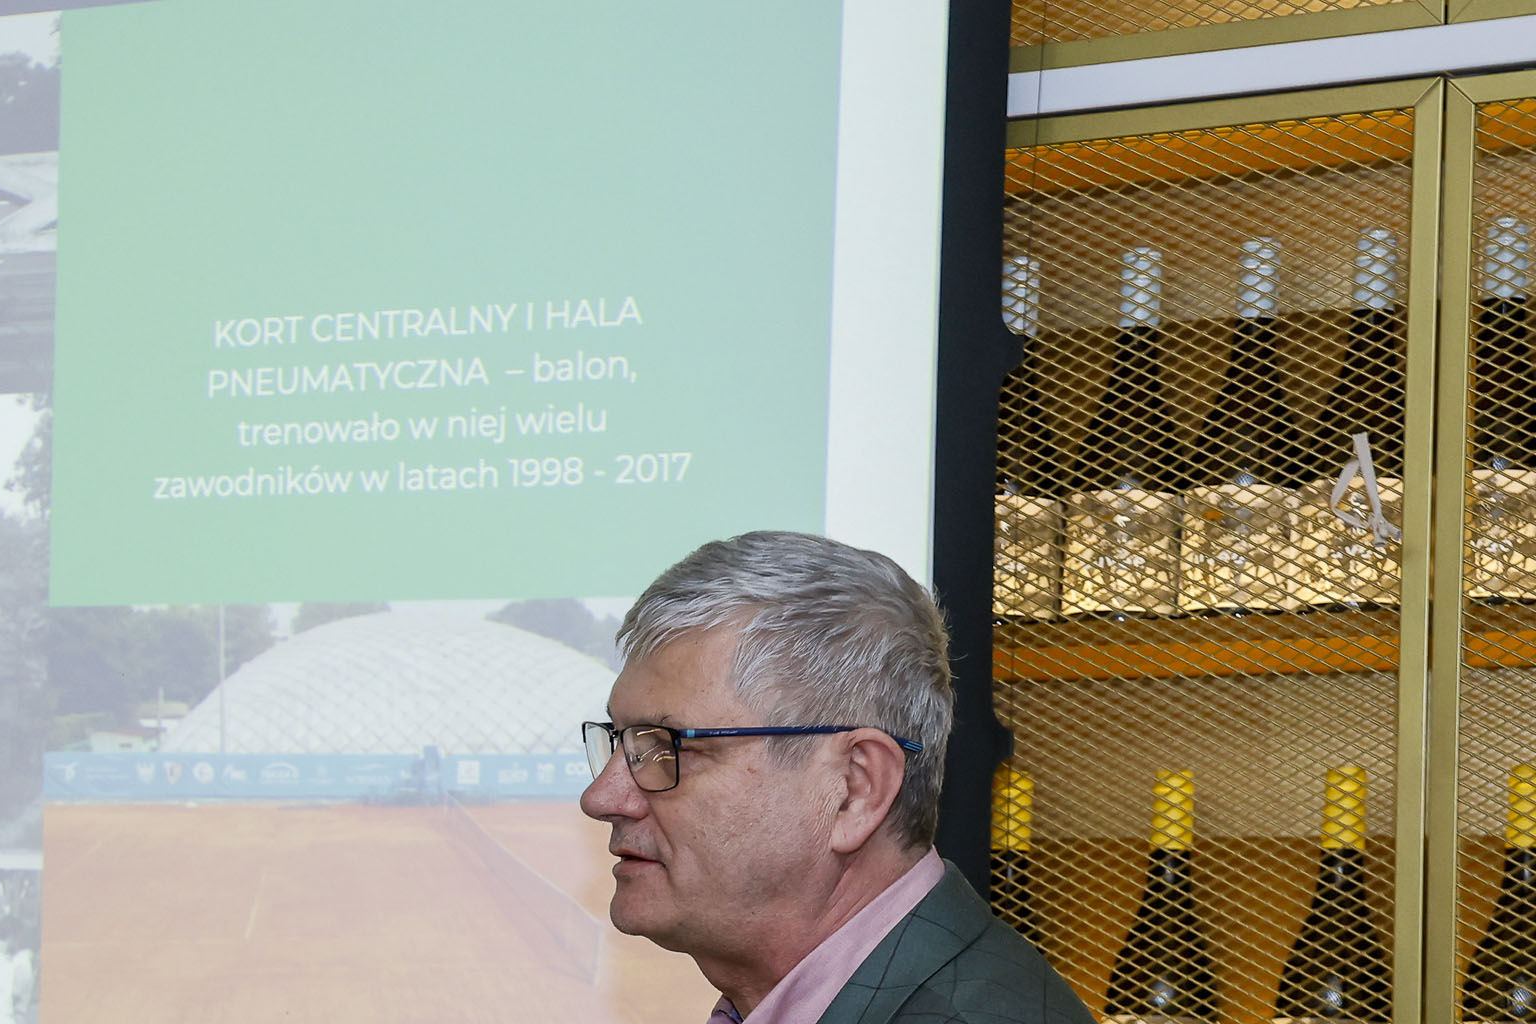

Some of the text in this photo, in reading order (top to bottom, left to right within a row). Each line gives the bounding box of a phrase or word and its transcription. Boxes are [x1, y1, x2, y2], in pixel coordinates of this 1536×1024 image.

[213, 296, 642, 348] KORT CENTRALNY I HALA
[207, 357, 488, 398] PNEUMATYCZNA
[533, 351, 638, 385] balon,
[238, 402, 607, 446] trenowało w niej wielu
[153, 463, 352, 499] zawodników
[360, 468, 390, 492] w
[398, 457, 498, 491] latach
[509, 456, 583, 487] 1998
[615, 451, 694, 484] 2017
